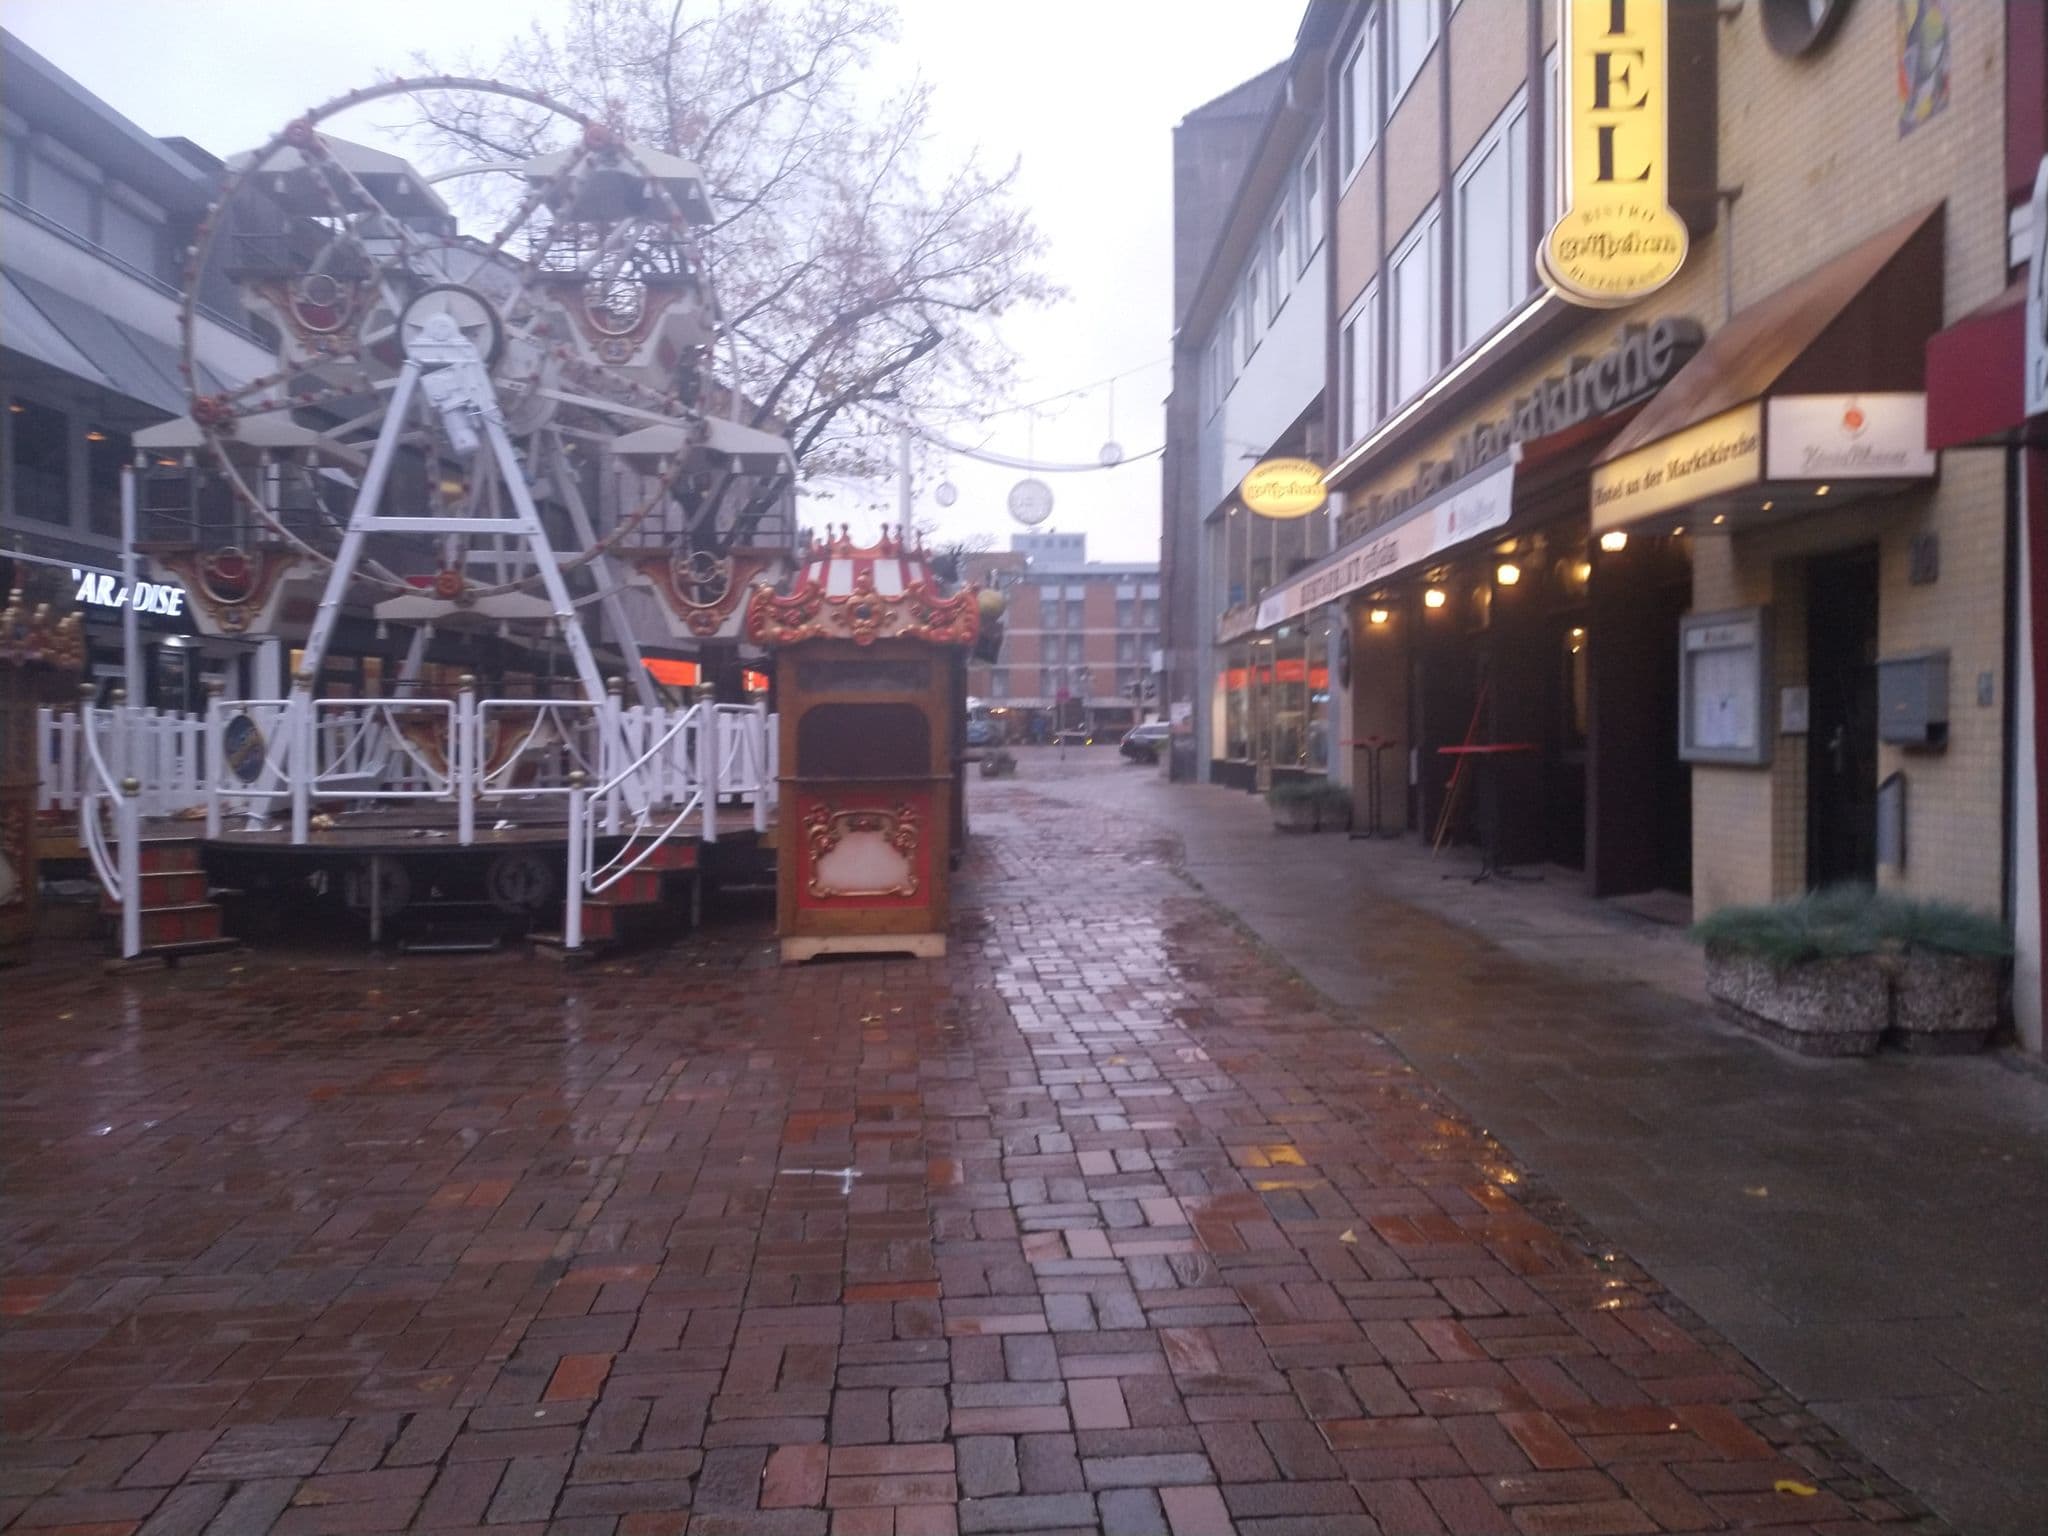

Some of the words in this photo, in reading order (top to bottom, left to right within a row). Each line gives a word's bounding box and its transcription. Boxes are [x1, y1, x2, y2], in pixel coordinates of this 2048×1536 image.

[1452, 317, 1675, 478] Marktkirche
[1644, 469, 1664, 491] der
[1666, 431, 1759, 483] Marktkirche
[72, 568, 187, 617] ARADISE
